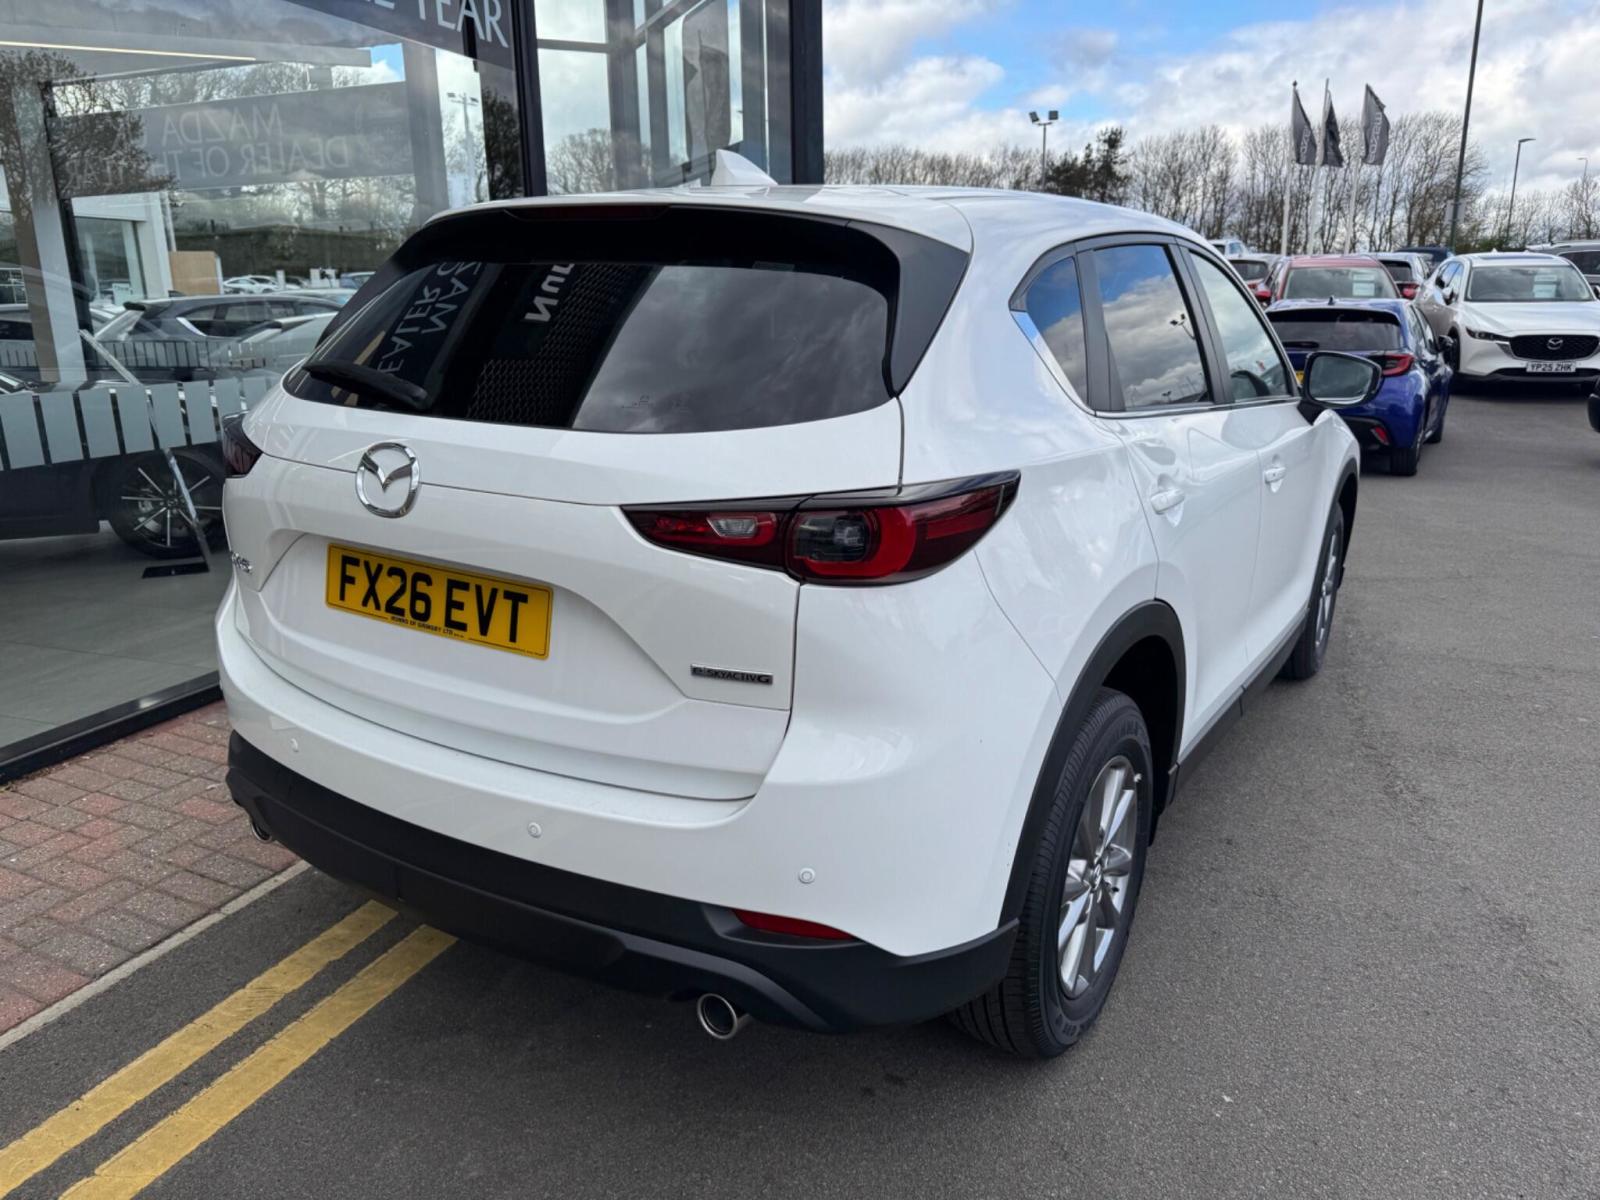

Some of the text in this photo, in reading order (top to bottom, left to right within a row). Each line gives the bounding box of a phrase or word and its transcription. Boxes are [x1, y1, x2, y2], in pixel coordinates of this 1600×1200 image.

[1530, 363, 1573, 372] YP25 ZHK
[339, 554, 529, 643] FX26 EVT
